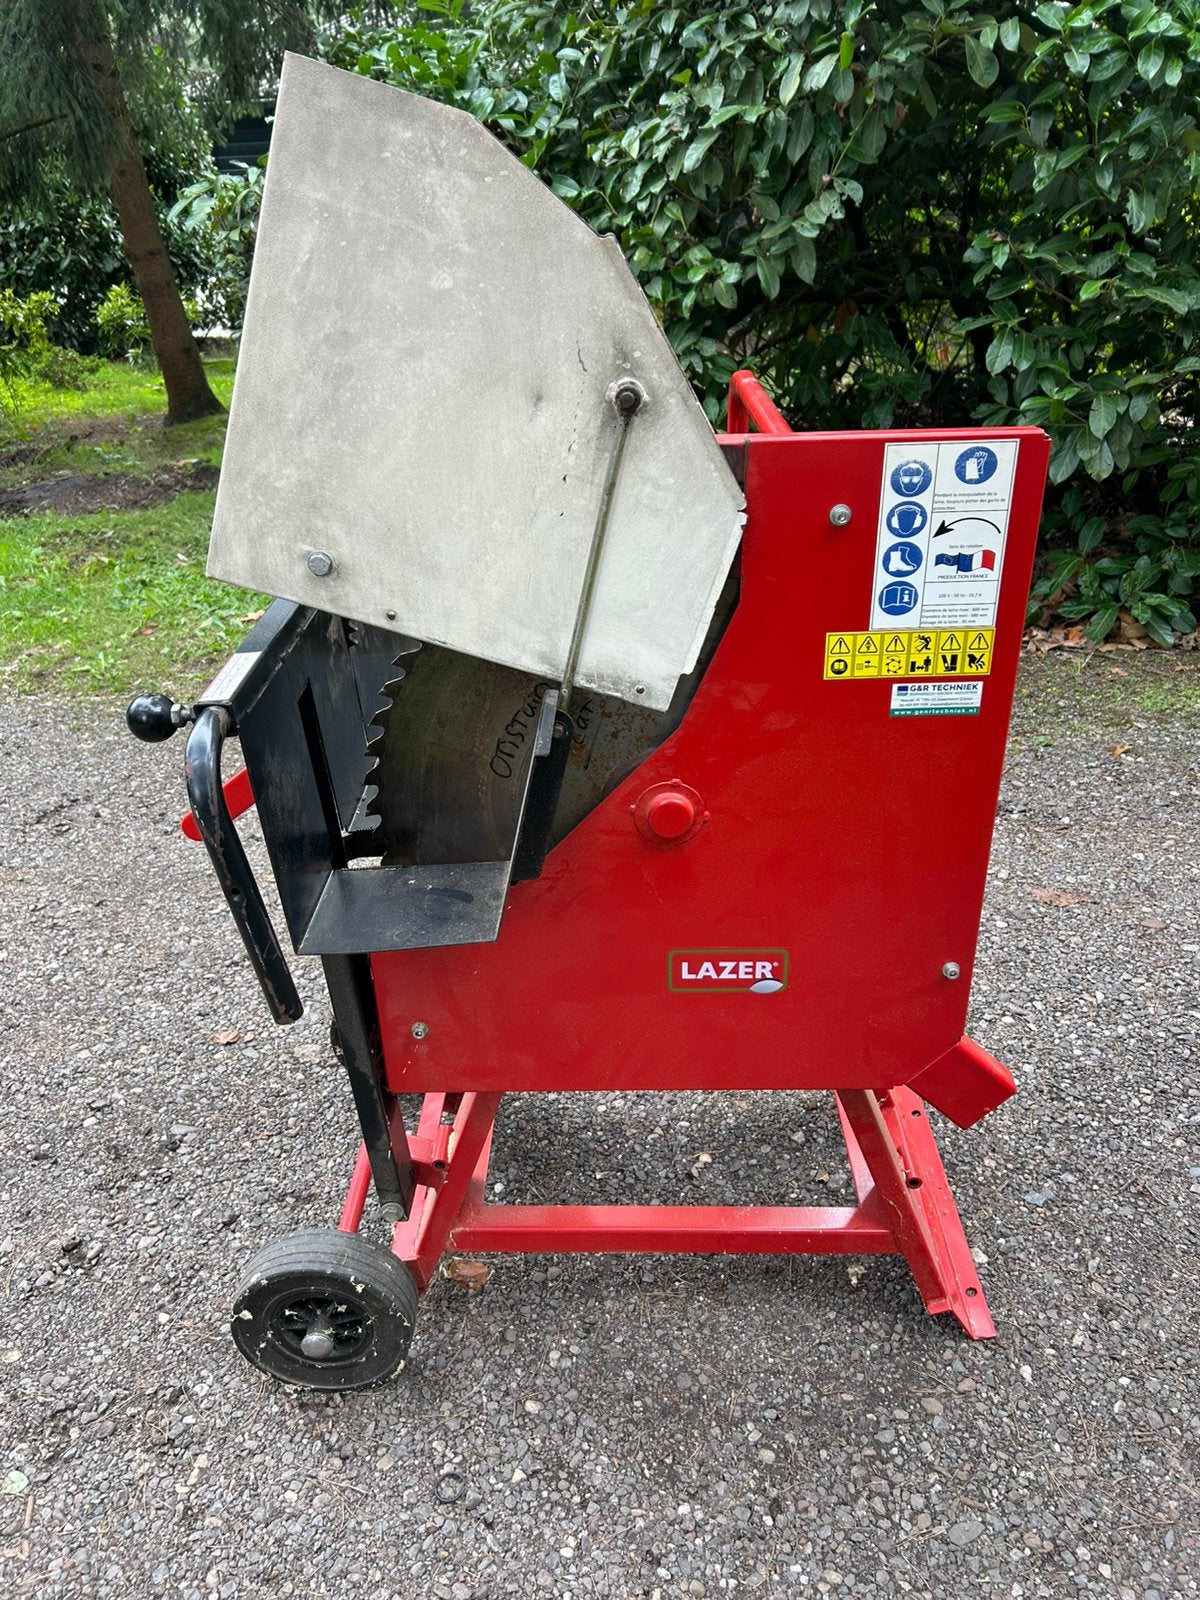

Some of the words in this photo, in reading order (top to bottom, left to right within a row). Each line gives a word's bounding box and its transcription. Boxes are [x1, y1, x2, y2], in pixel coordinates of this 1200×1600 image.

[931, 683, 979, 691] TECHNIEK
[894, 708, 977, 716] www.genrtechniek.nl
[681, 961, 774, 979] LAZER
